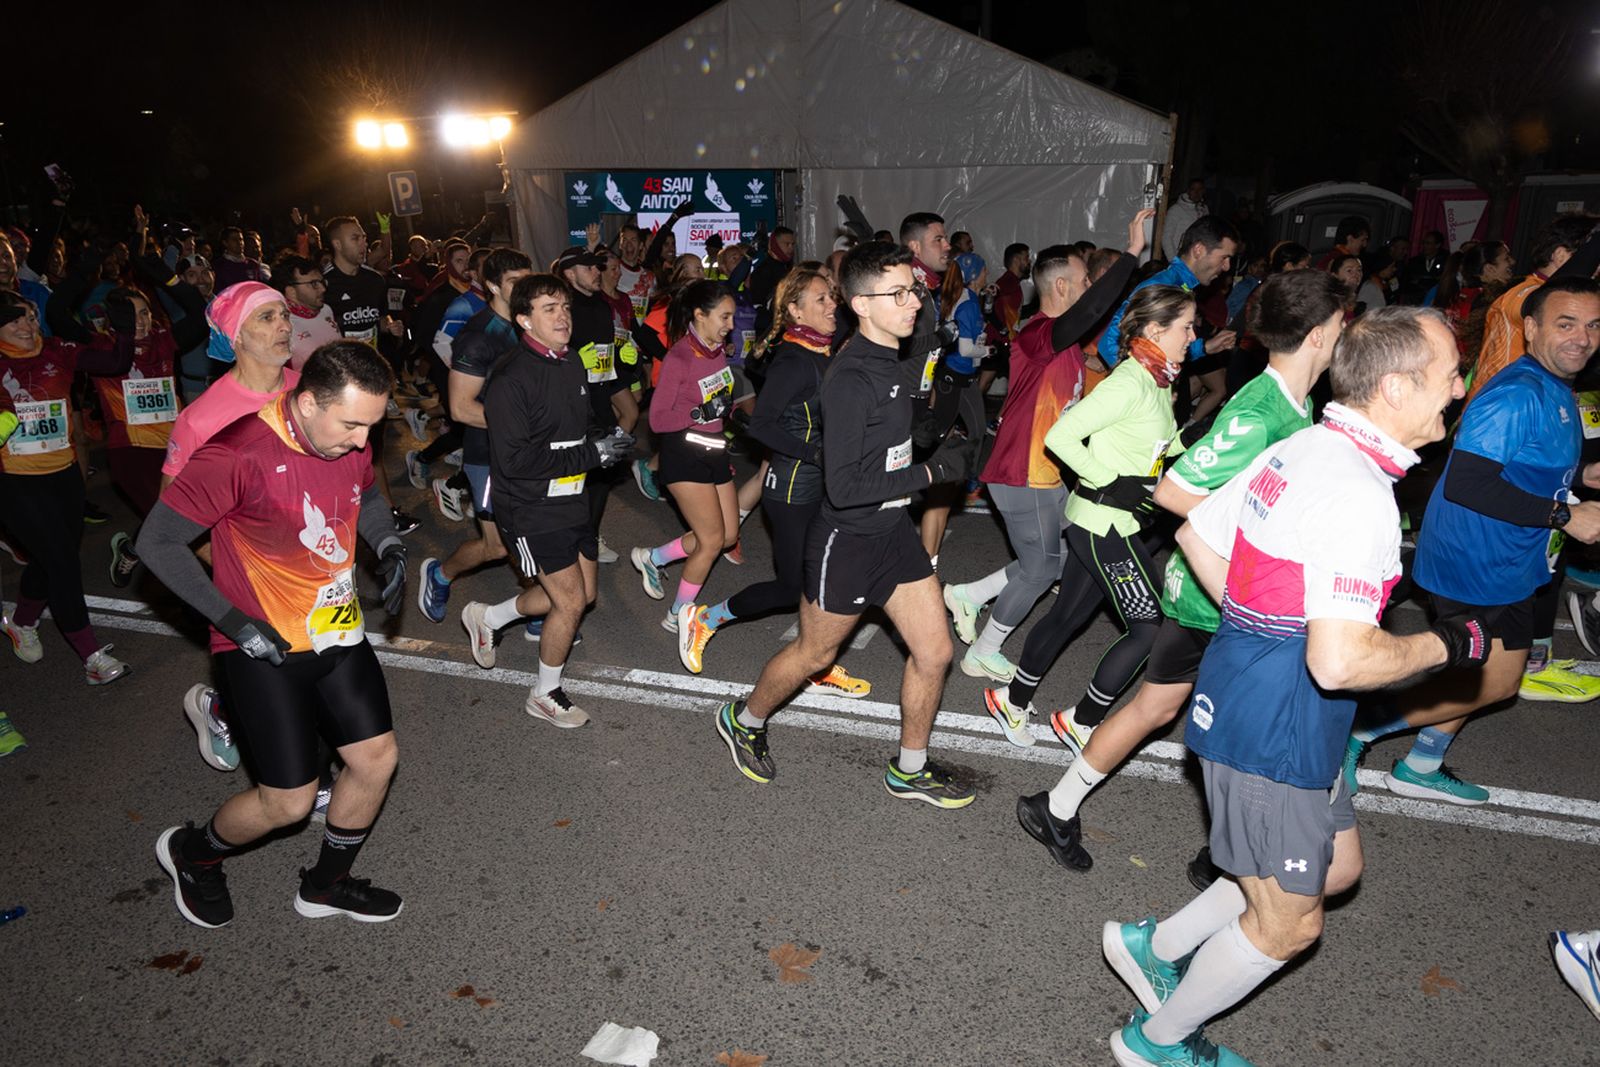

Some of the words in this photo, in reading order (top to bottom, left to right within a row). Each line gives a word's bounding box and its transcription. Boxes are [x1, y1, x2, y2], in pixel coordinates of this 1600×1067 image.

[395, 176, 414, 201] P
[640, 191, 692, 210] ANTÓN
[715, 229, 741, 241] ANT
[136, 394, 170, 409] 9361
[315, 534, 335, 556] 43
